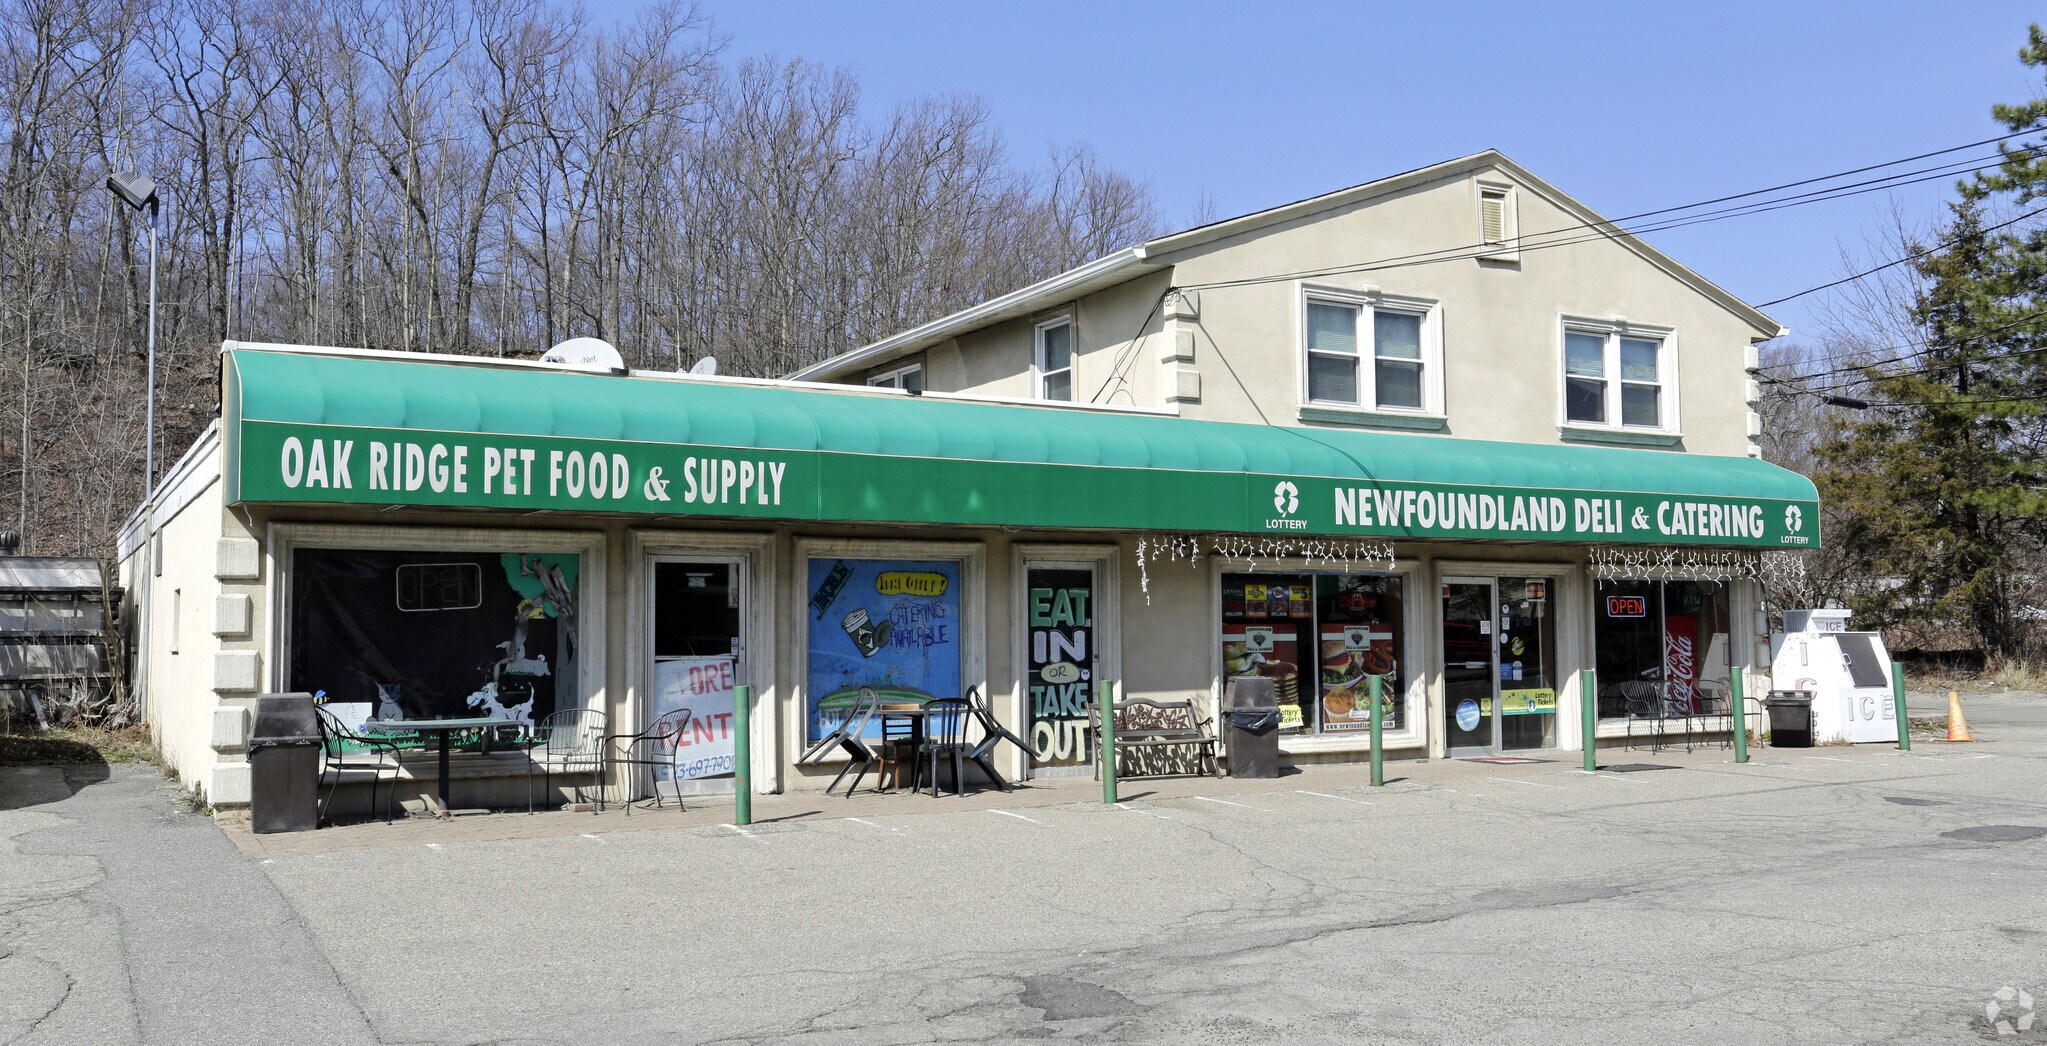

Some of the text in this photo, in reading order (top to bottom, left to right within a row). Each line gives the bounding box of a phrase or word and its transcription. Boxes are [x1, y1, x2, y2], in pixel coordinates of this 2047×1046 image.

[281, 437, 787, 506] OAK RIDGE PET FOOD & SUPPLY
[1265, 518, 1308, 530] LOTTERY
[1334, 487, 1765, 539] NEWFOUNDLAND DELI & CATERING
[1780, 535, 1809, 545] LOTTERY
[402, 570, 477, 603] OPEN
[889, 600, 946, 626] CATERING
[1030, 588, 1089, 628] EAT
[1609, 598, 1643, 615] OPEN
[889, 624, 949, 649] AVAILABLE
[1825, 621, 1843, 632] ICE
[1033, 629, 1086, 664] IN
[1049, 665, 1068, 677] OR
[1030, 683, 1089, 718] TAKE
[1534, 692, 1552, 700] Lottery
[1537, 698, 1554, 706] Tickets
[1848, 694, 1895, 722] ICE
[1280, 708, 1299, 718] ottery
[1281, 714, 1301, 723] ickets
[657, 712, 733, 750] RENT
[1031, 719, 1090, 763] OUT
